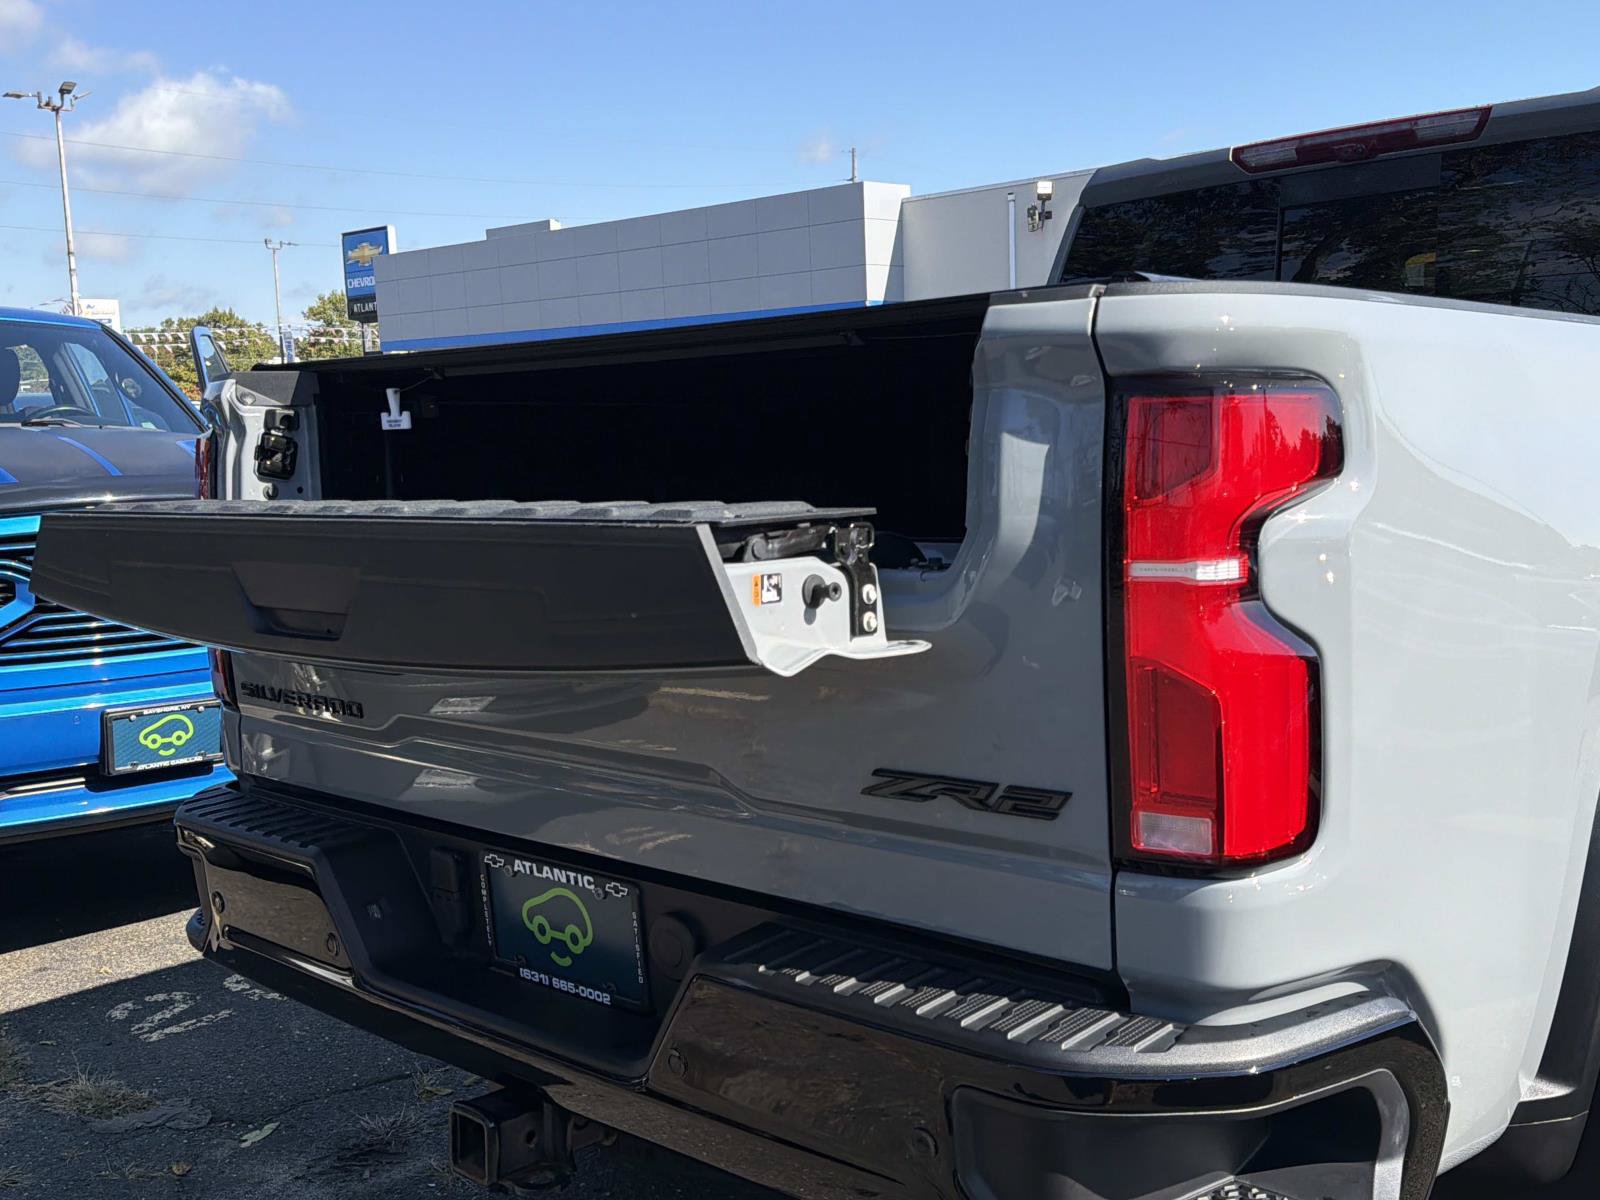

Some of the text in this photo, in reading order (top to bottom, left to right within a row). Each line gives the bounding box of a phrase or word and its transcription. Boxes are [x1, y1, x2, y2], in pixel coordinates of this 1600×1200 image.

[240, 682, 364, 718] SILVERADO
[860, 767, 1073, 821] ZR2
[513, 859, 596, 890] ATLANTIC
[480, 873, 492, 947] COMPLETELY
[632, 911, 644, 984] SATISFIED
[520, 967, 611, 1005] (631) 665-0002
